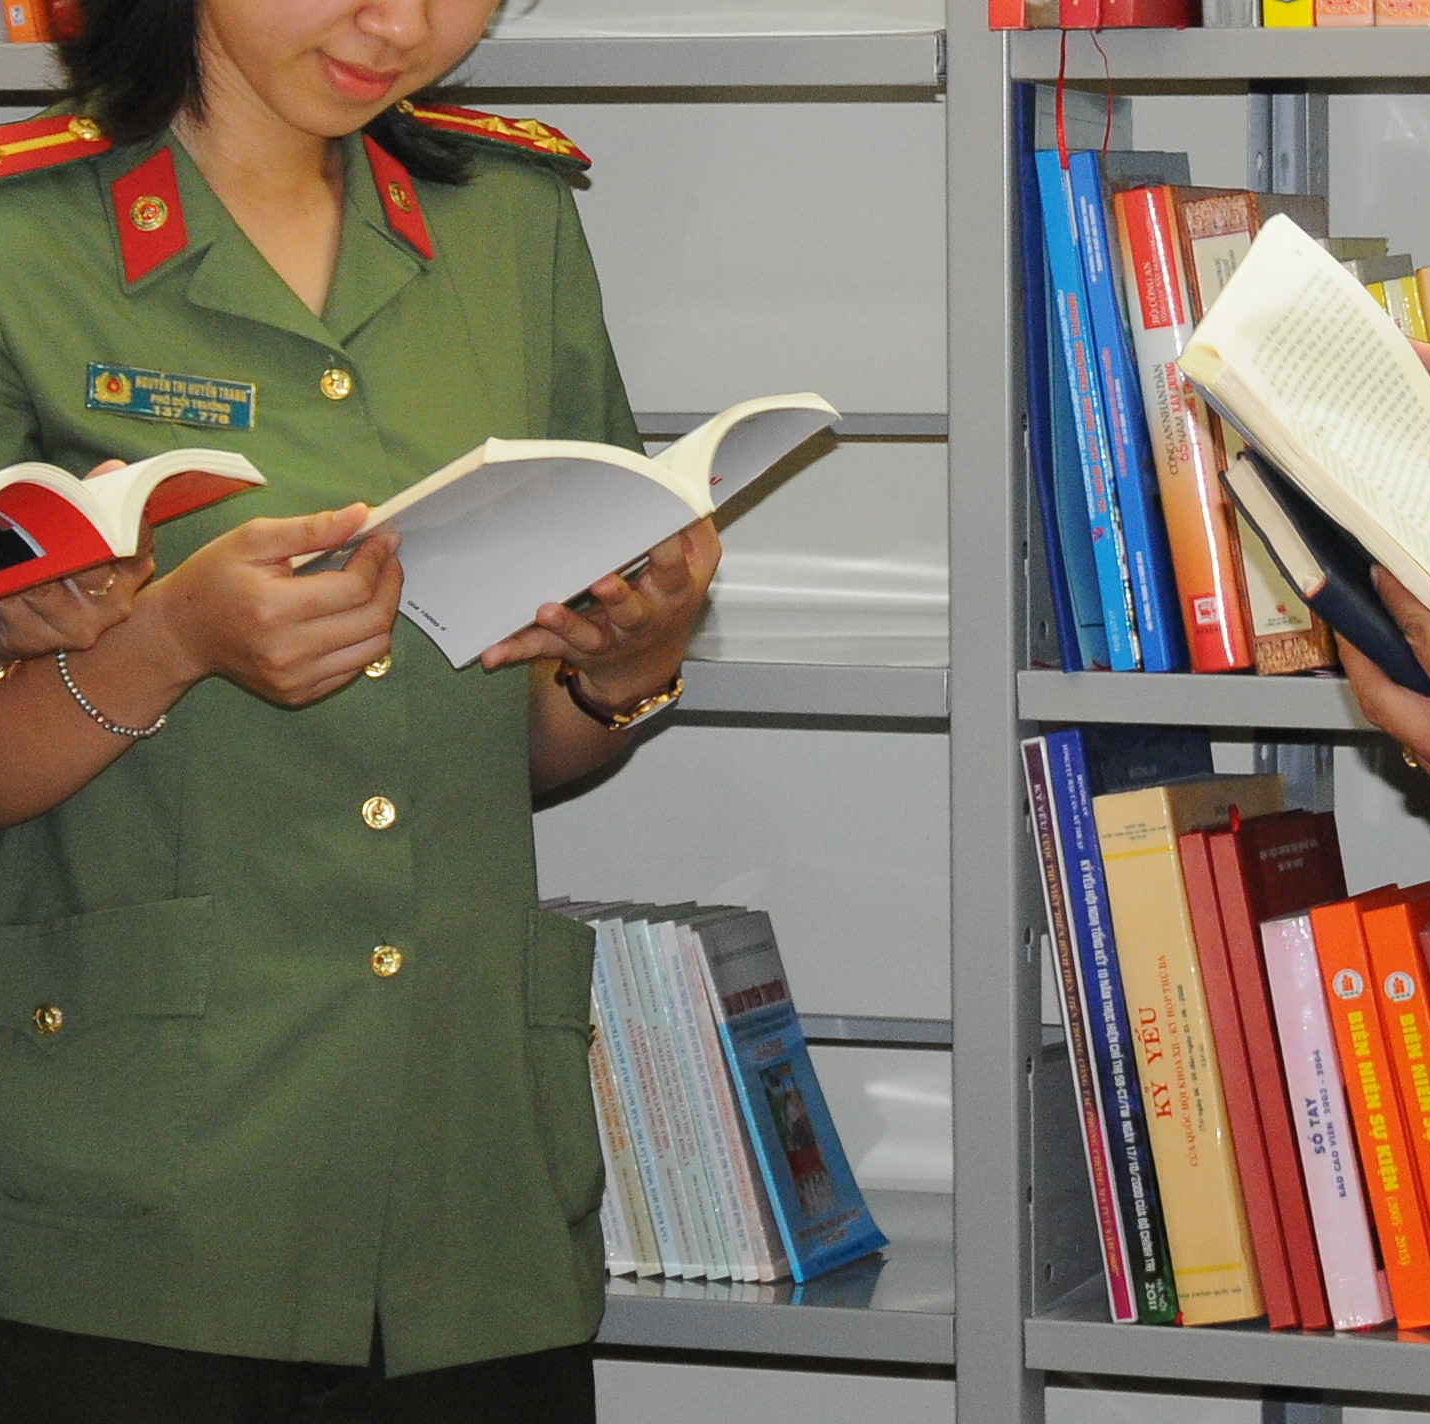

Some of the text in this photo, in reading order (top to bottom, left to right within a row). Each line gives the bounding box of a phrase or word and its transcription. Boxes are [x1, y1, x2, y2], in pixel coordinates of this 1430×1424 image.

[1135, 1004, 1172, 1120] KỶ YẾU
[1399, 1012, 1425, 1060] BIÊN
[1304, 1095, 1325, 1155] SỔ TAY
[1346, 1009, 1401, 1193] BIÊN NIÊN SỰ KIỆN
